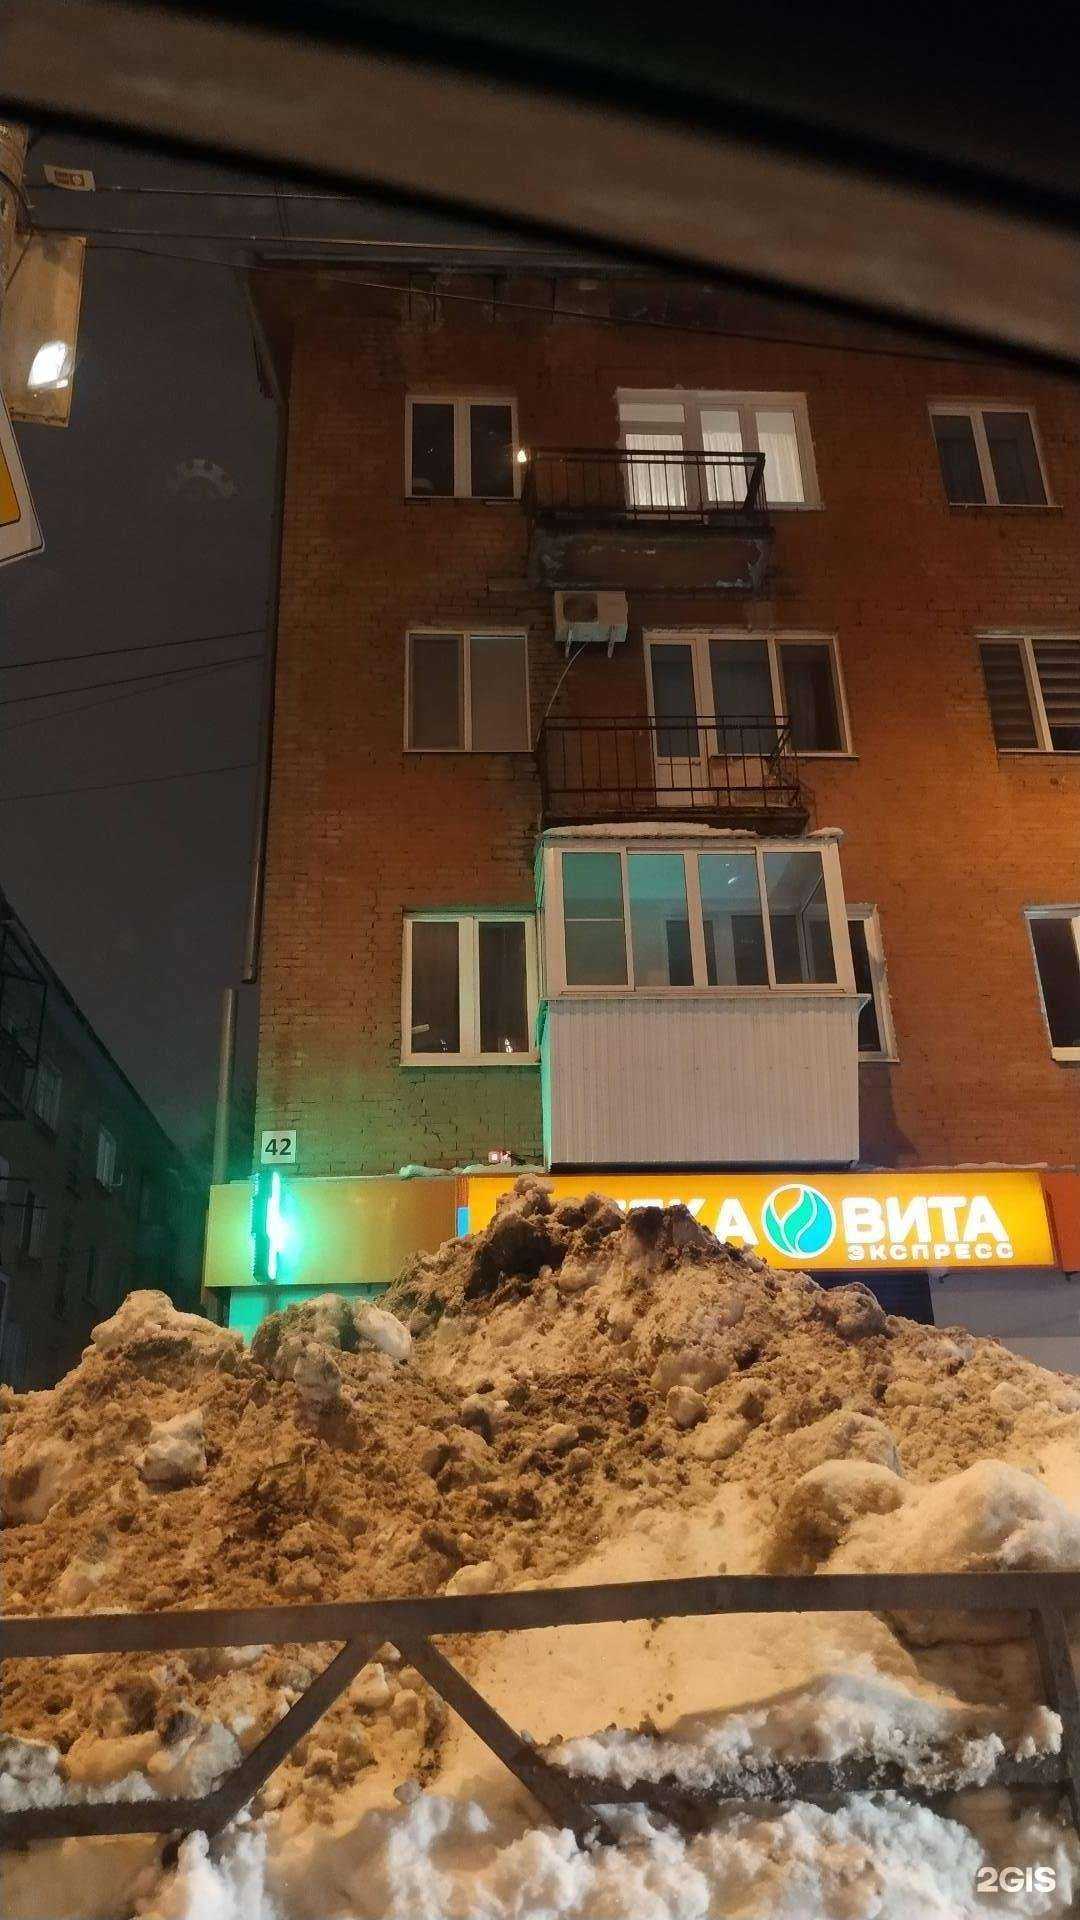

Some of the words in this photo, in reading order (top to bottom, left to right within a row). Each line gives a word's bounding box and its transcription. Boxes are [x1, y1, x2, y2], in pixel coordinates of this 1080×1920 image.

[264, 1137, 292, 1156] 42
[841, 1195, 1011, 1244] ВИТА
[847, 1242, 1014, 1261] ЭКСПРЕСС
